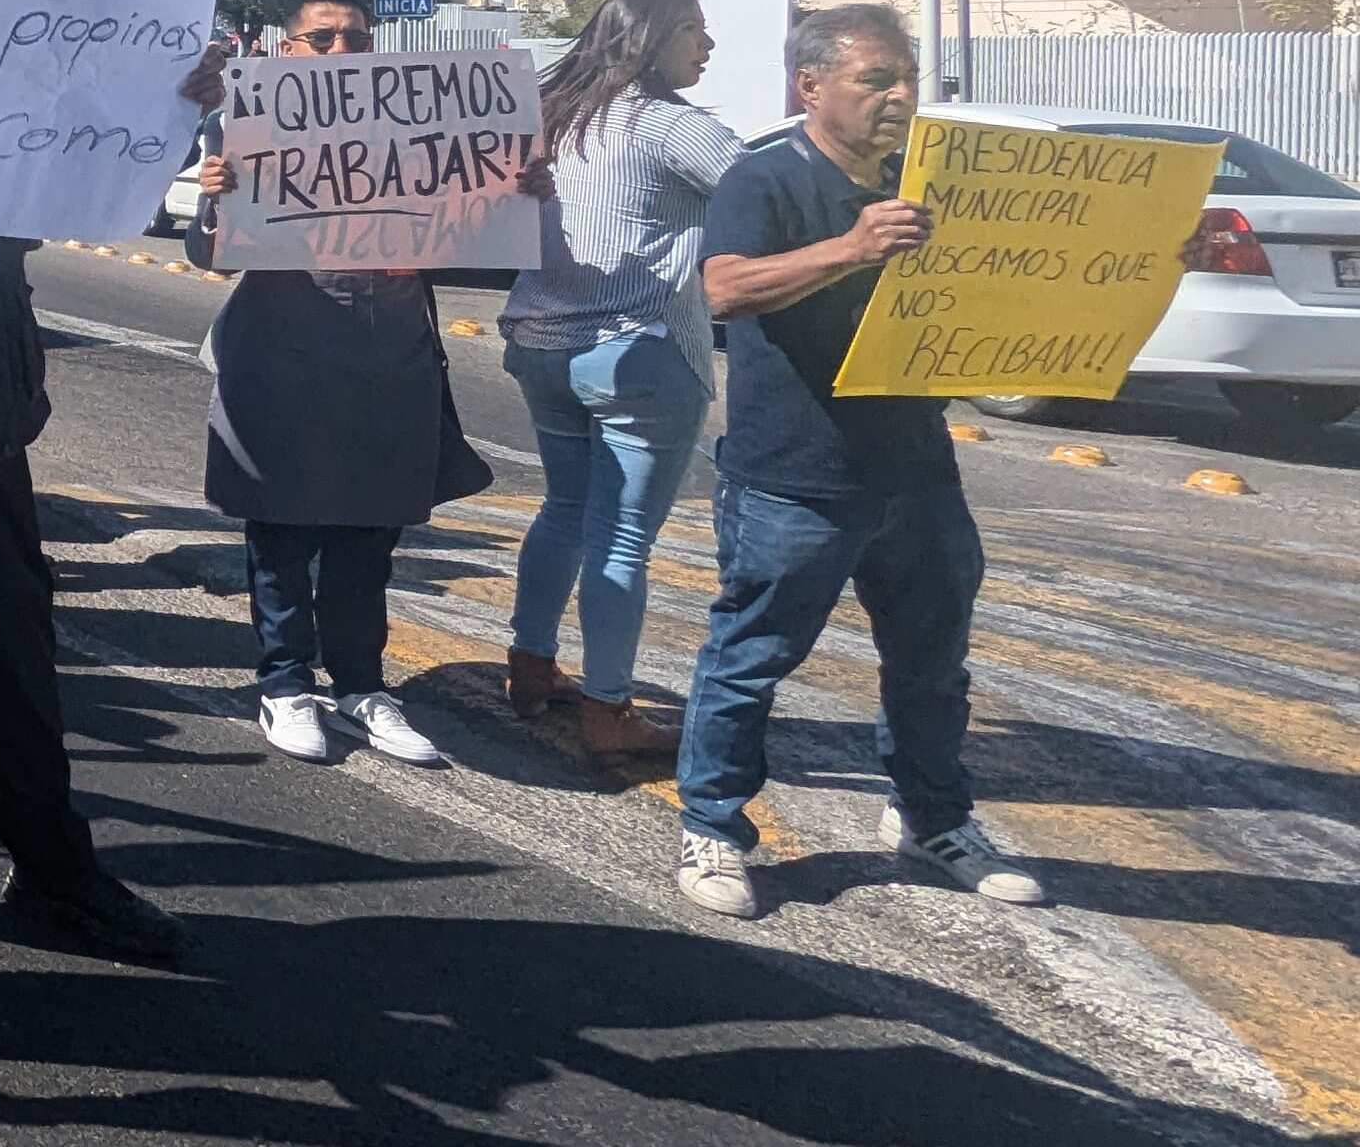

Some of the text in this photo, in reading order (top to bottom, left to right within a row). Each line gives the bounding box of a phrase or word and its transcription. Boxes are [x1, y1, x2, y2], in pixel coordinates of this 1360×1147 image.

[918, 123, 1158, 187] PRESIDENCIA
[923, 181, 1092, 226] MUNICIPAL
[897, 245, 1157, 285] BUSCAMOS QUE
[889, 286, 956, 320] NOS
[903, 324, 1124, 380] RECIBAN!!
